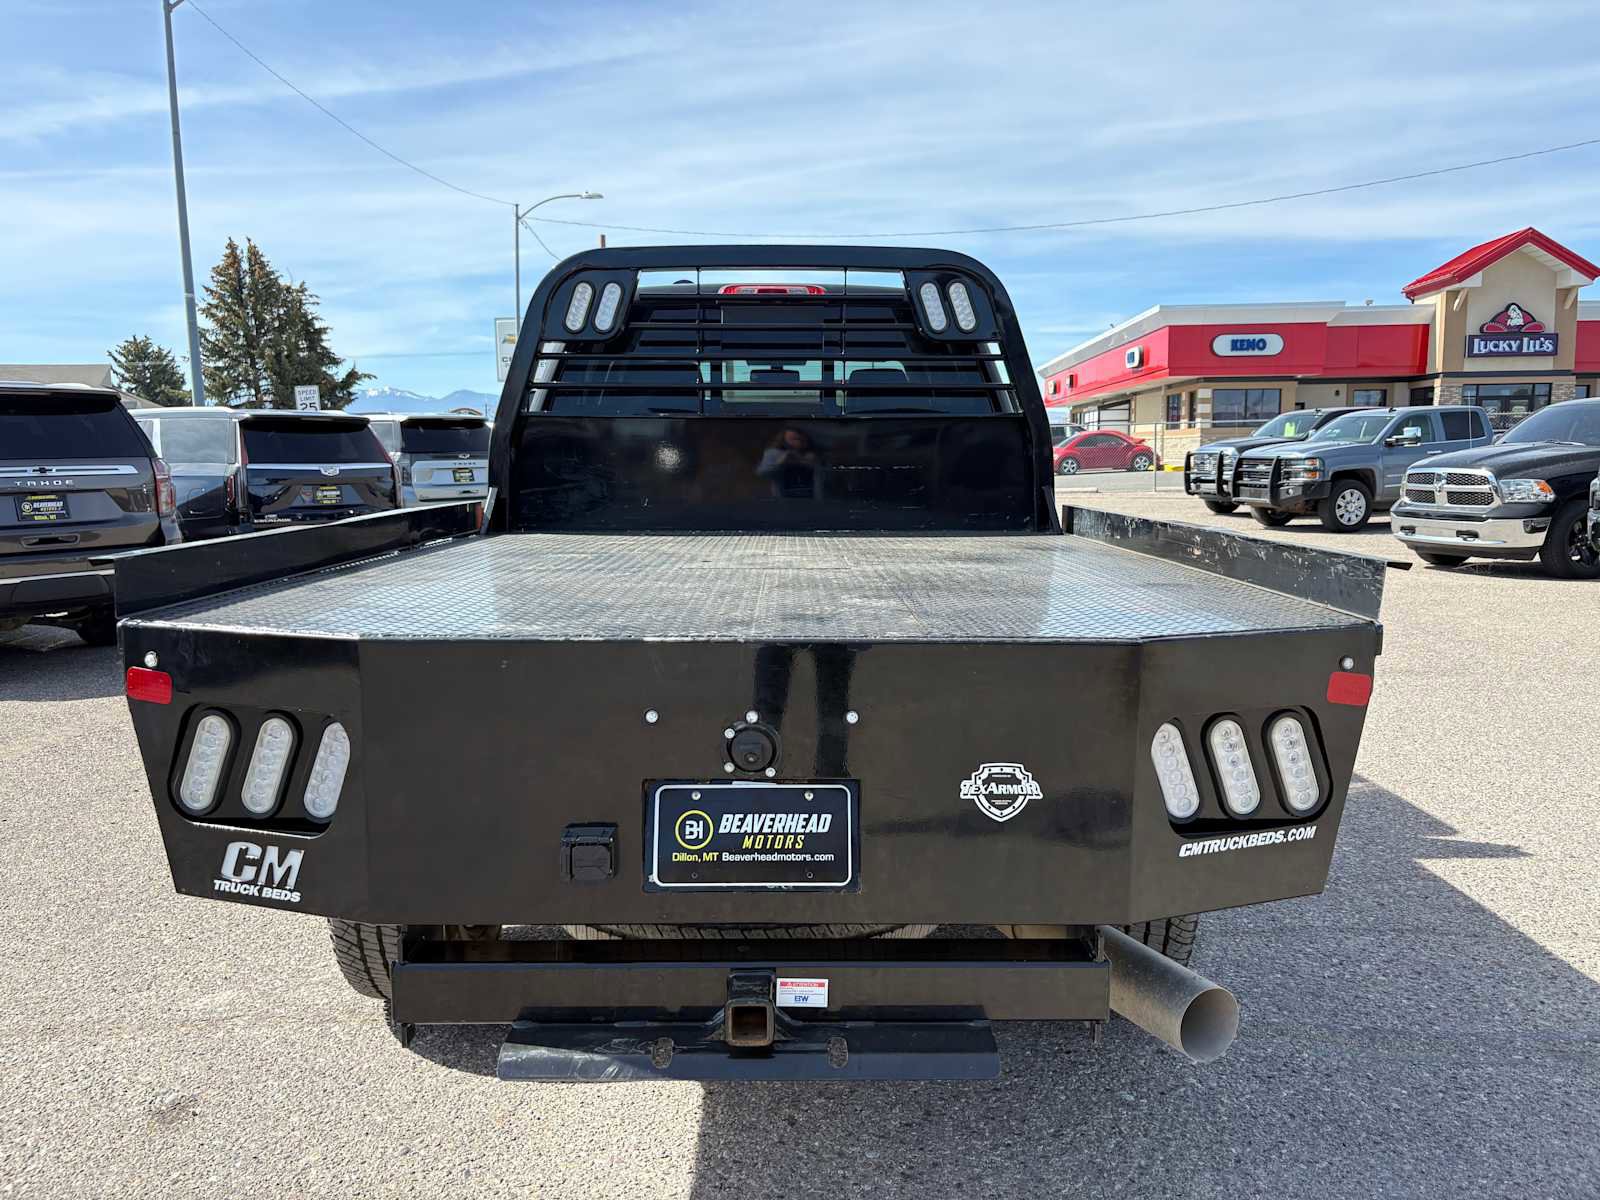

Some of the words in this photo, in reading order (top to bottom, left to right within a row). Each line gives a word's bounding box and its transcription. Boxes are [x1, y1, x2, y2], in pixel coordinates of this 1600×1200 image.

[1231, 338, 1267, 351] KENO
[1473, 338, 1520, 354] LUCKY
[300, 402, 318, 411] 25
[719, 813, 832, 833] BEAVERHEAD
[742, 834, 804, 849] MOTORS
[1179, 826, 1317, 857] CMTRUCKBEDS.COM
[672, 852, 701, 862] Dillon,
[703, 852, 719, 861] MT
[722, 852, 834, 862] Beaverheadmotors.com
[221, 841, 305, 890] CM
[213, 880, 260, 896] TRUCK
[261, 887, 301, 902] BEDS
